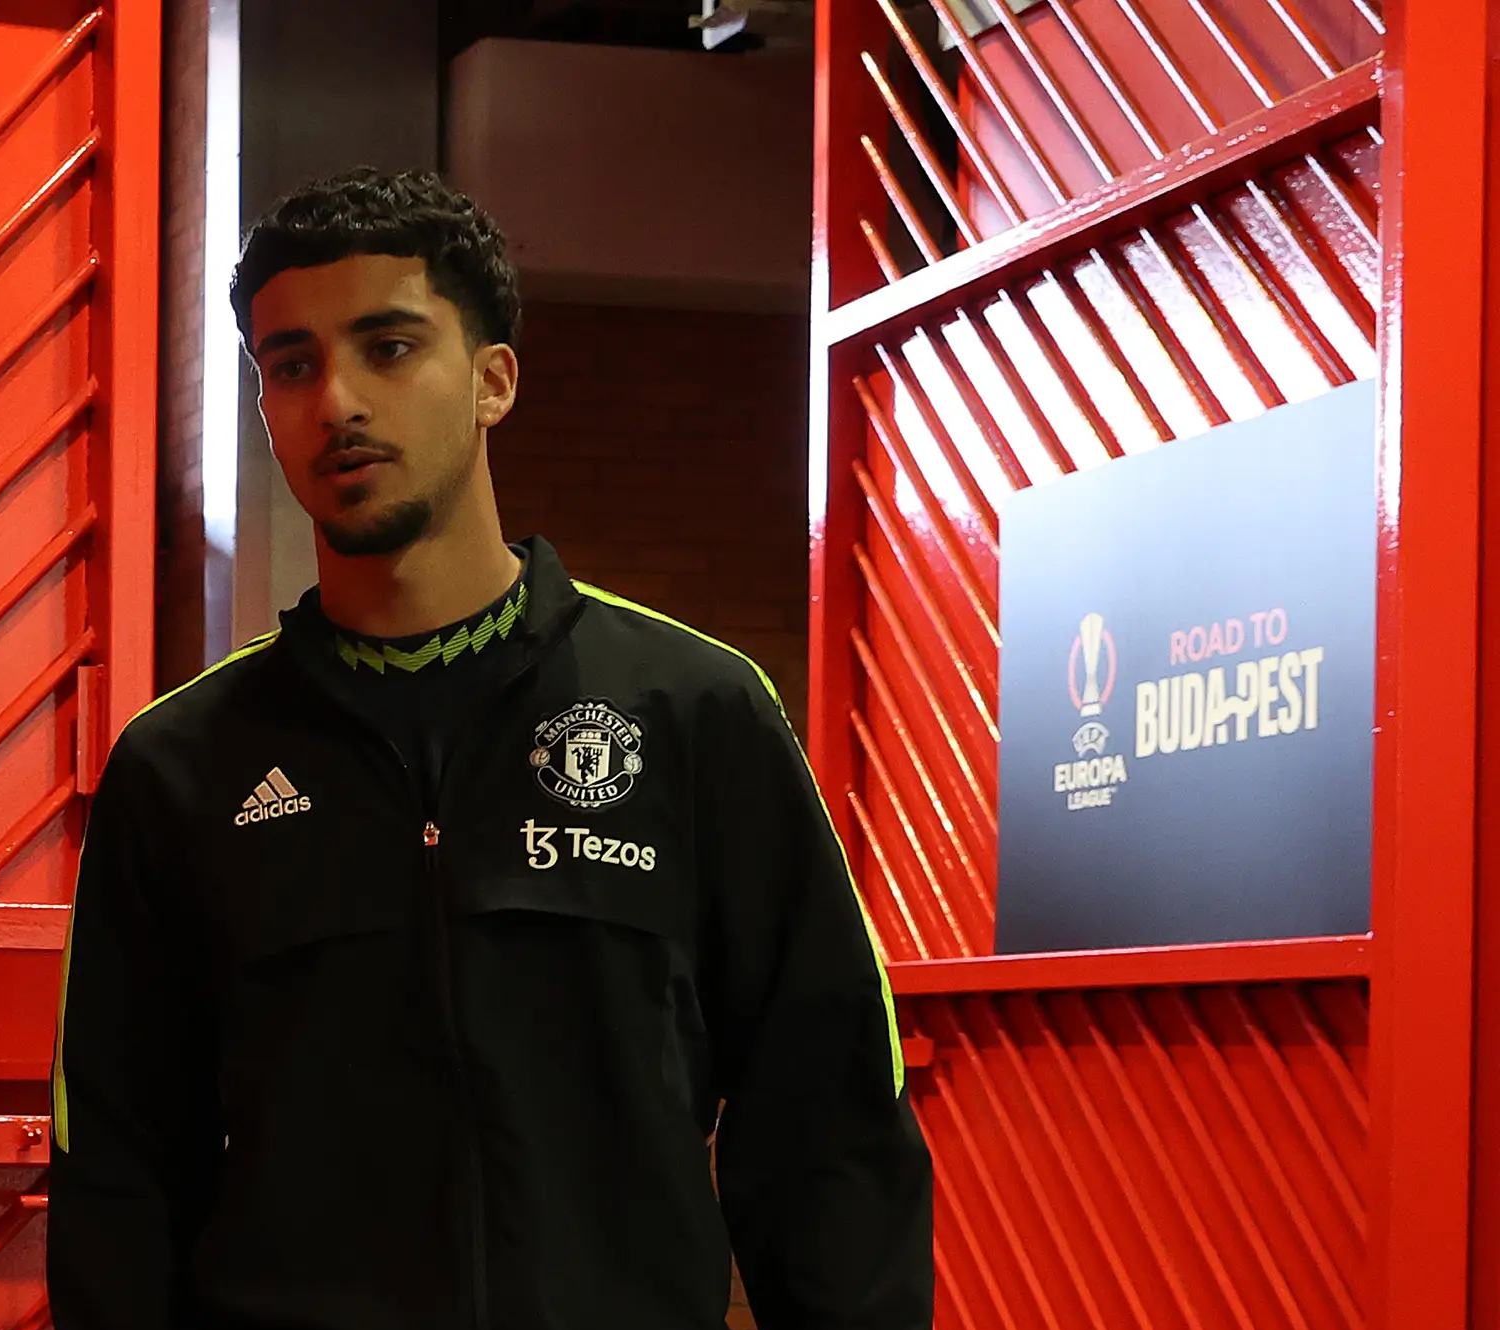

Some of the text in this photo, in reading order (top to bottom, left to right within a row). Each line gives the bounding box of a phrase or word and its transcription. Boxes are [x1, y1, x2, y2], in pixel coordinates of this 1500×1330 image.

[1170, 608, 1288, 666] ROAD TO
[1136, 646, 1324, 759] BUDAPEST
[544, 710, 633, 746] MANCHESTER
[554, 780, 618, 800] UNITED
[1055, 754, 1128, 792] EUROPA
[234, 796, 312, 826] adidas
[565, 828, 656, 871] Tezos
